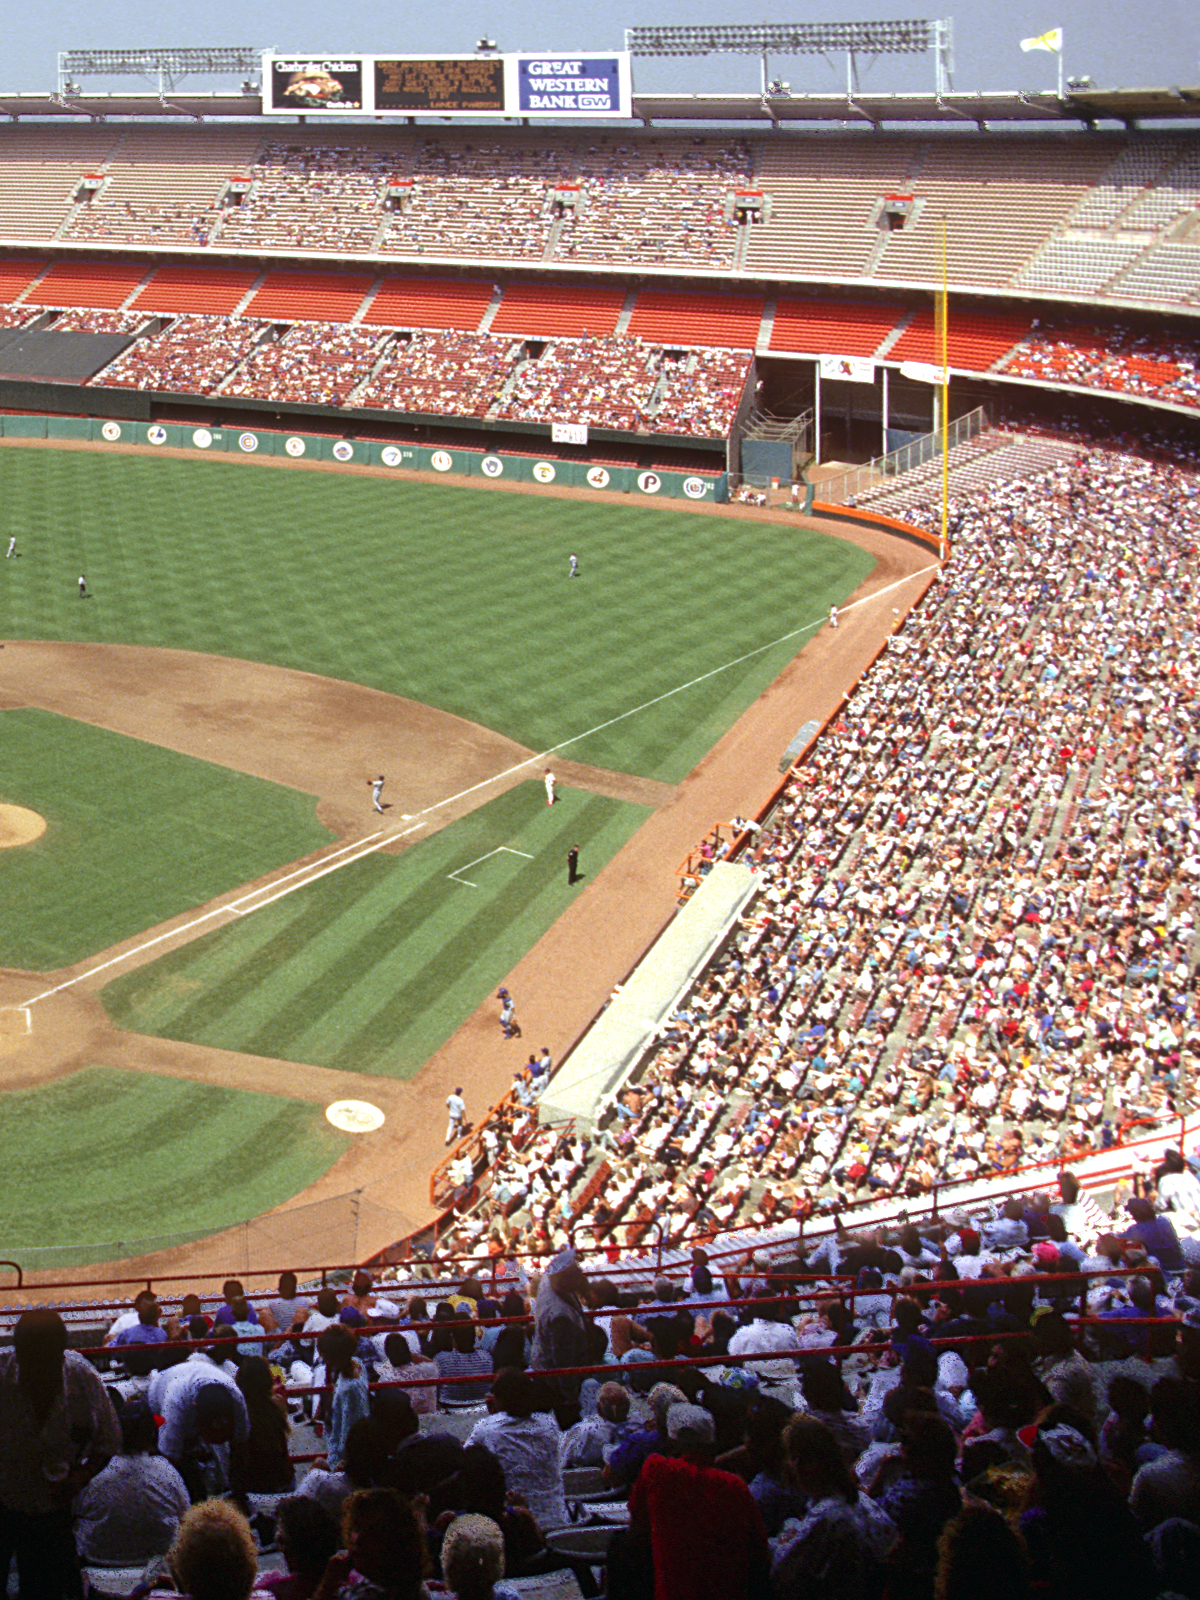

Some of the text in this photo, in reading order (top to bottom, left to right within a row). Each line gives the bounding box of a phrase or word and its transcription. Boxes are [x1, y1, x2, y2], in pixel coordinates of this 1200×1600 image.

[322, 61, 359, 73] Chicken
[528, 61, 583, 75] GREAT
[528, 78, 609, 92] WESTERN
[529, 95, 577, 108] BANK
[643, 475, 657, 490] P
